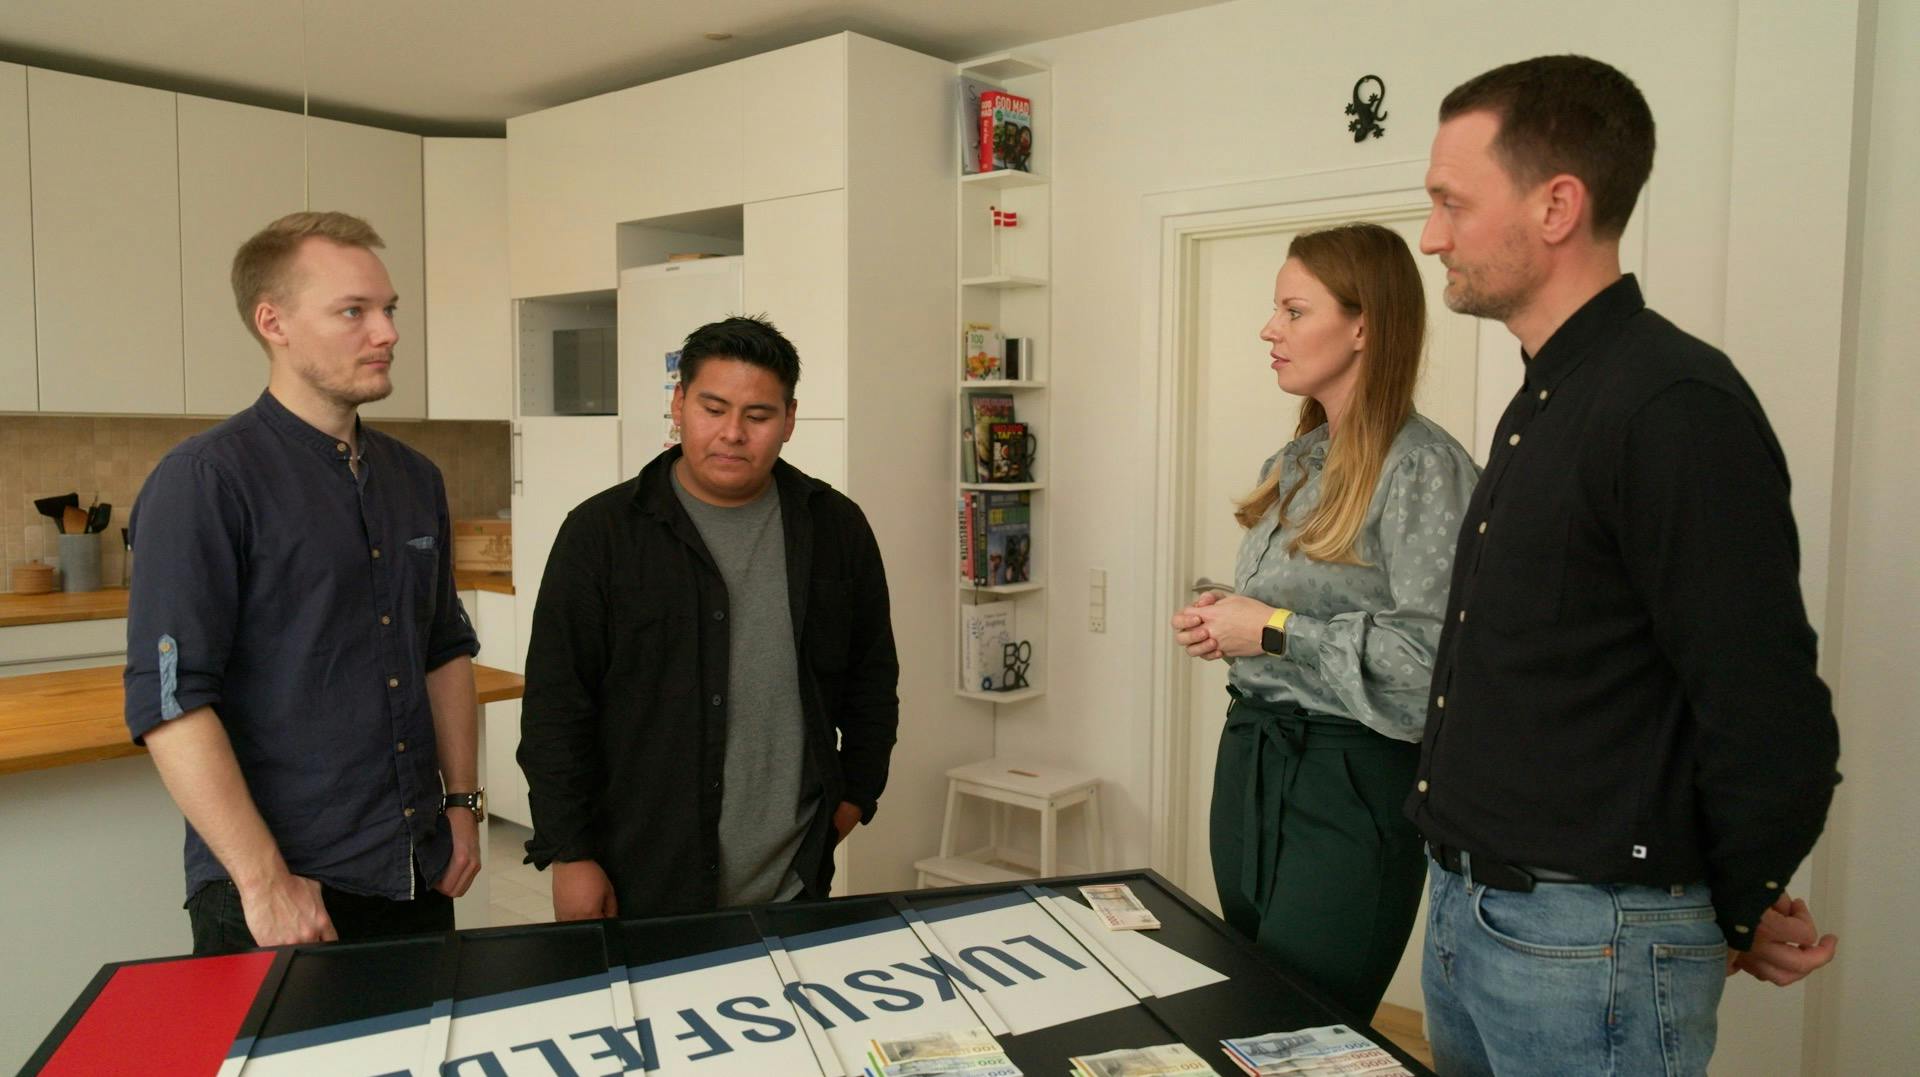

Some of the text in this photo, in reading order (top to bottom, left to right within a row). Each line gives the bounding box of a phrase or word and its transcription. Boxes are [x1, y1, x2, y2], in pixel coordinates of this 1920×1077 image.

[995, 96, 1030, 114] GOD MAD
[971, 334, 984, 344] 100
[1004, 640, 1031, 668] BO
[1003, 663, 1030, 688] OK
[372, 934, 1087, 1077] LUKSUSFÆLD
[972, 1045, 997, 1053] 100
[1345, 1041, 1370, 1050] 500
[1351, 1051, 1383, 1060] 1000
[978, 1058, 1005, 1066] 200
[1180, 1060, 1206, 1071] 100
[1361, 1057, 1392, 1068] 1000
[988, 1069, 1015, 1077] 500
